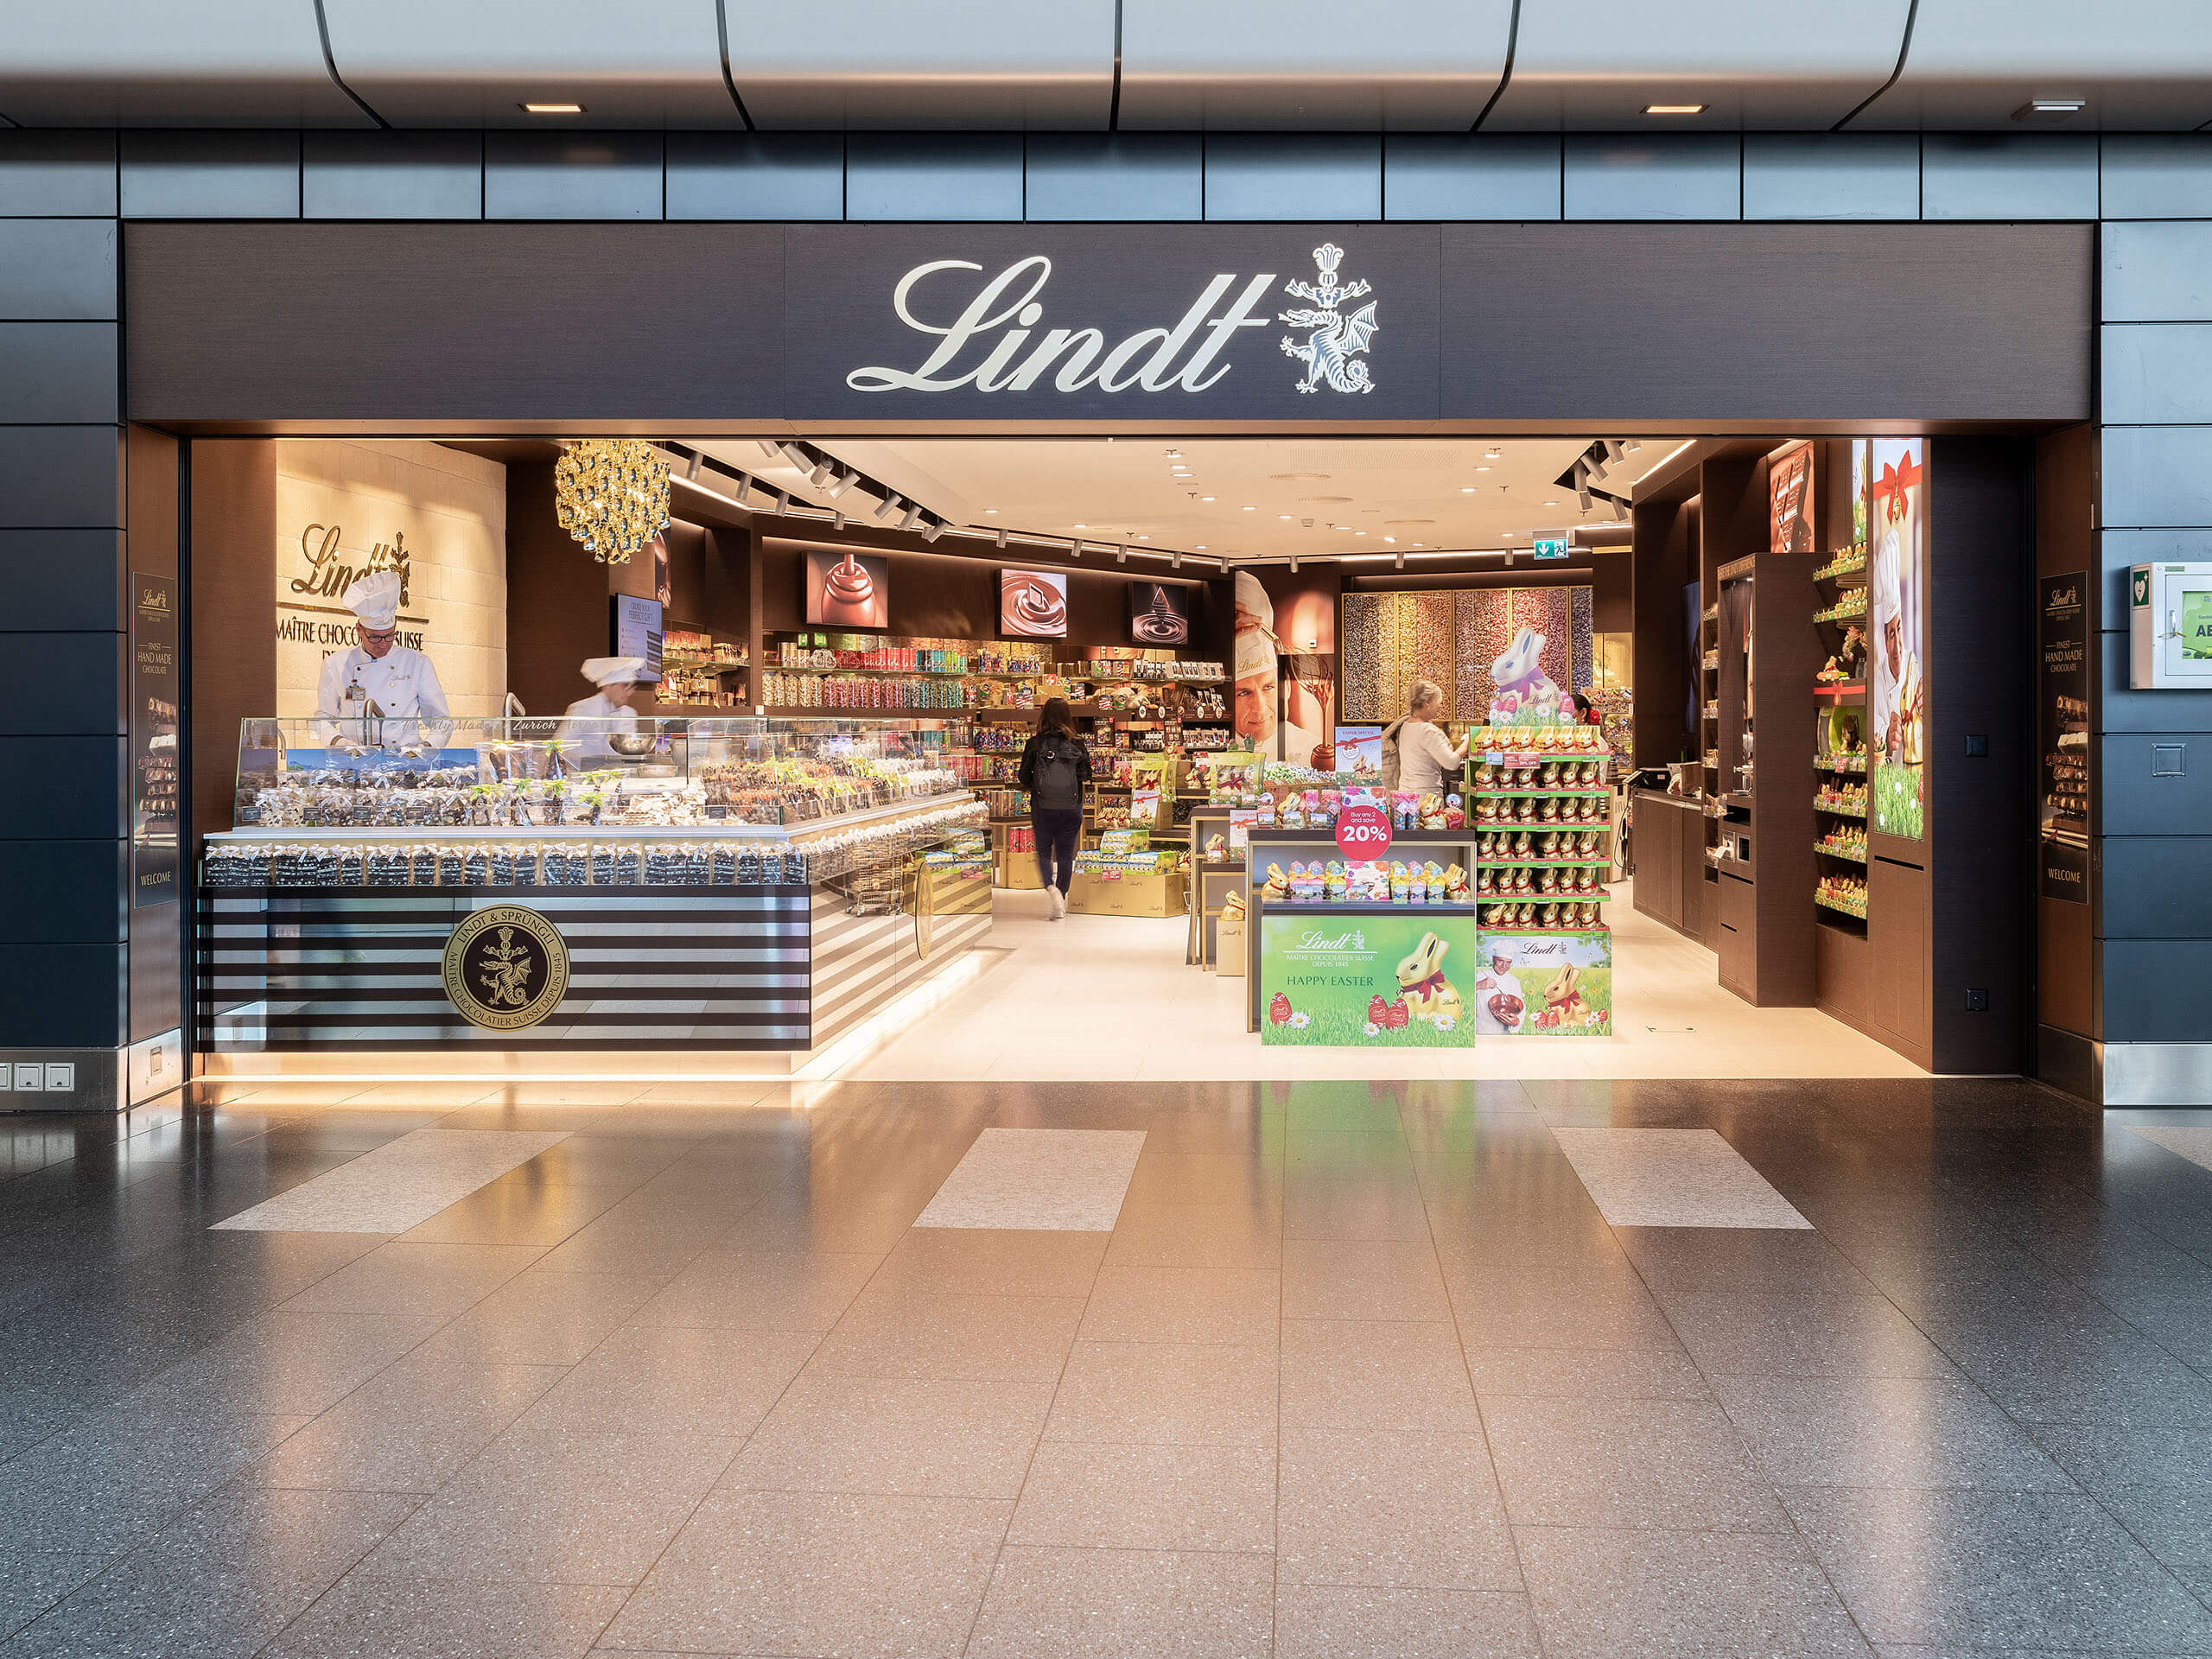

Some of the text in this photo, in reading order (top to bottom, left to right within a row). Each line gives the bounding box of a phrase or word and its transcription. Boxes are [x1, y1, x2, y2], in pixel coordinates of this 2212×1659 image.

[846, 256, 1276, 393] Lindt
[143, 588, 162, 607] Lindt
[2050, 588, 2071, 607] Lindt
[276, 615, 315, 643] MAÎTRE
[138, 652, 171, 664] HAND MADE
[2045, 650, 2082, 663] HAND MADE
[143, 664, 166, 675] CHOCOLATE
[2050, 664, 2076, 672] CHOCOLATE
[1529, 693, 1553, 705] Lindt
[512, 720, 557, 731] Zurich
[1343, 825, 1387, 842] 20%
[140, 871, 171, 886] WELCOME
[2048, 868, 2081, 883] WELCOME
[457, 912, 555, 944] LINDT & SPRÜNGLI
[1295, 931, 1351, 950] Lindt
[1521, 941, 1558, 955] Lindt
[1287, 976, 1374, 986] HAPPY EASTER
[454, 988, 512, 1027] CHOCOLATIER
[513, 1007, 543, 1025] SUISSE
[542, 976, 562, 1009] DEPUIS
[553, 952, 563, 974] 1845
